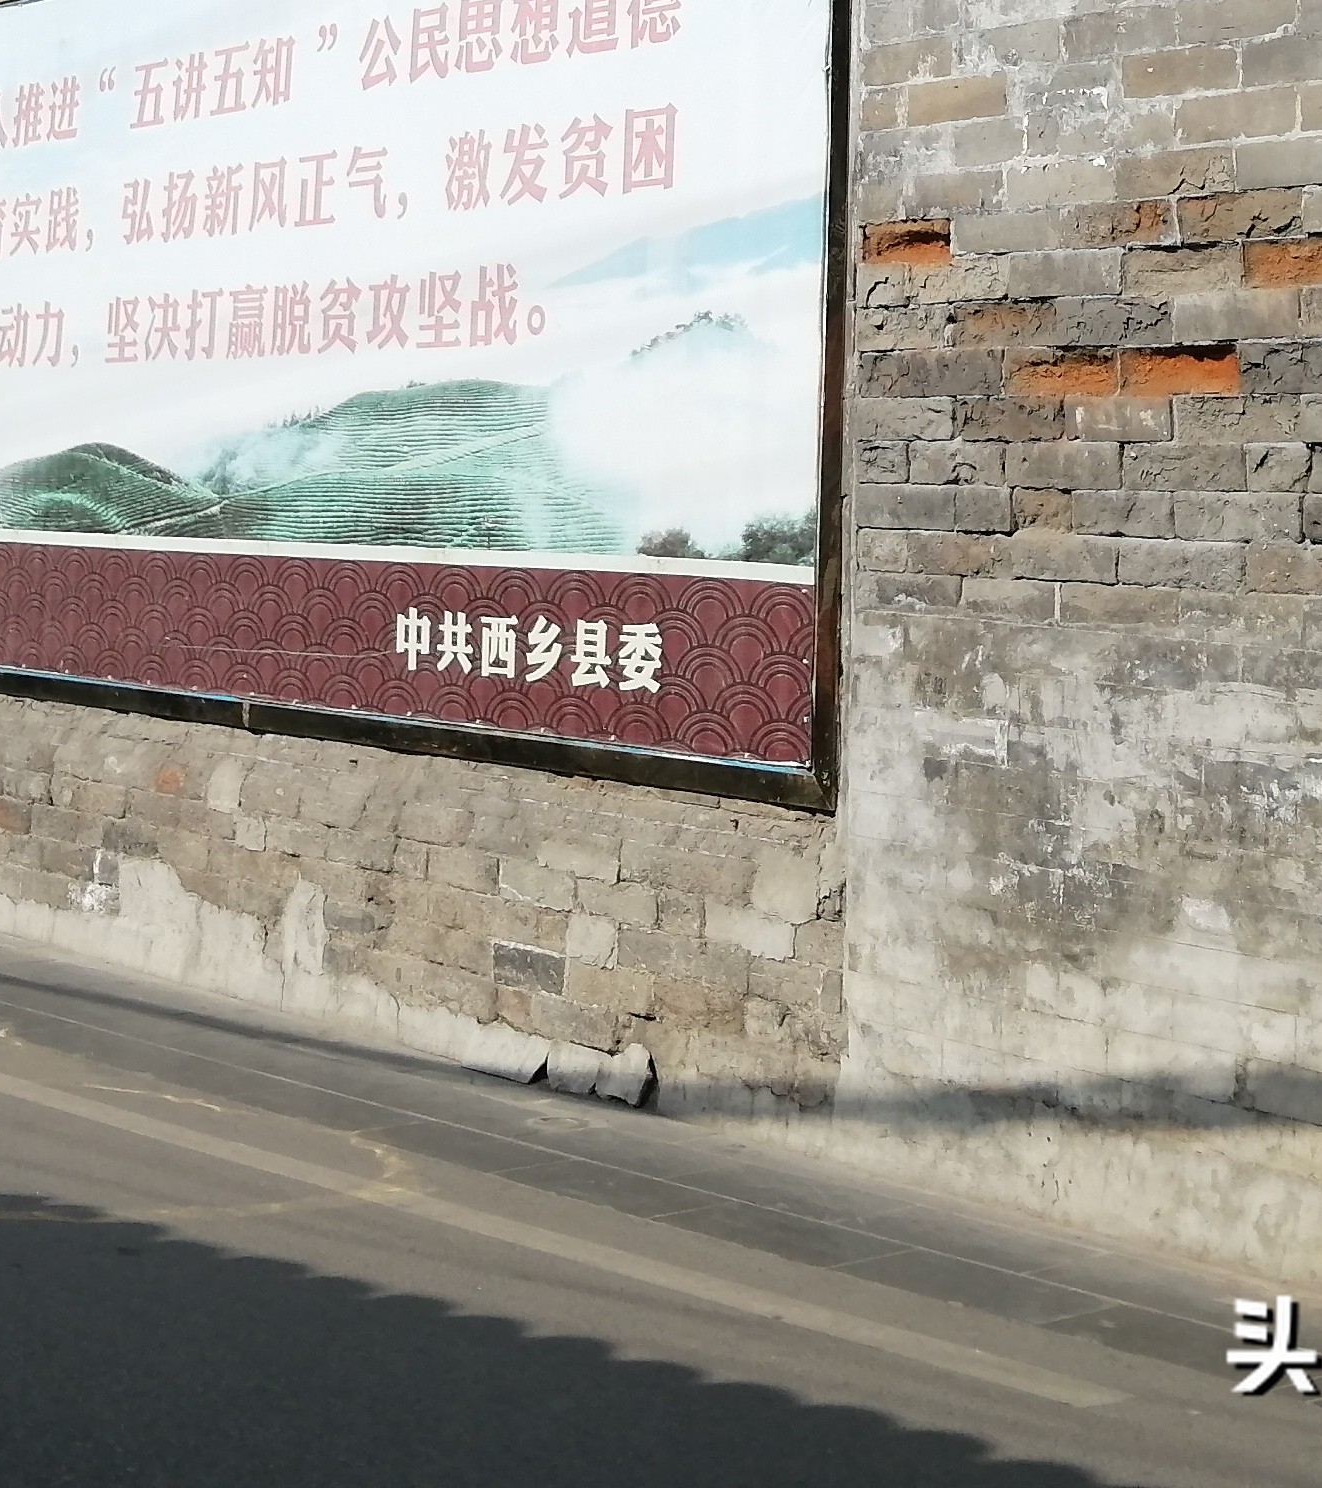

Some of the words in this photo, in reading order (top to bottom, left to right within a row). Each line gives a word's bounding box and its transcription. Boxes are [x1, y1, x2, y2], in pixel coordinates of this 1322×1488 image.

[396, 606, 663, 694] 中共西乡县委
